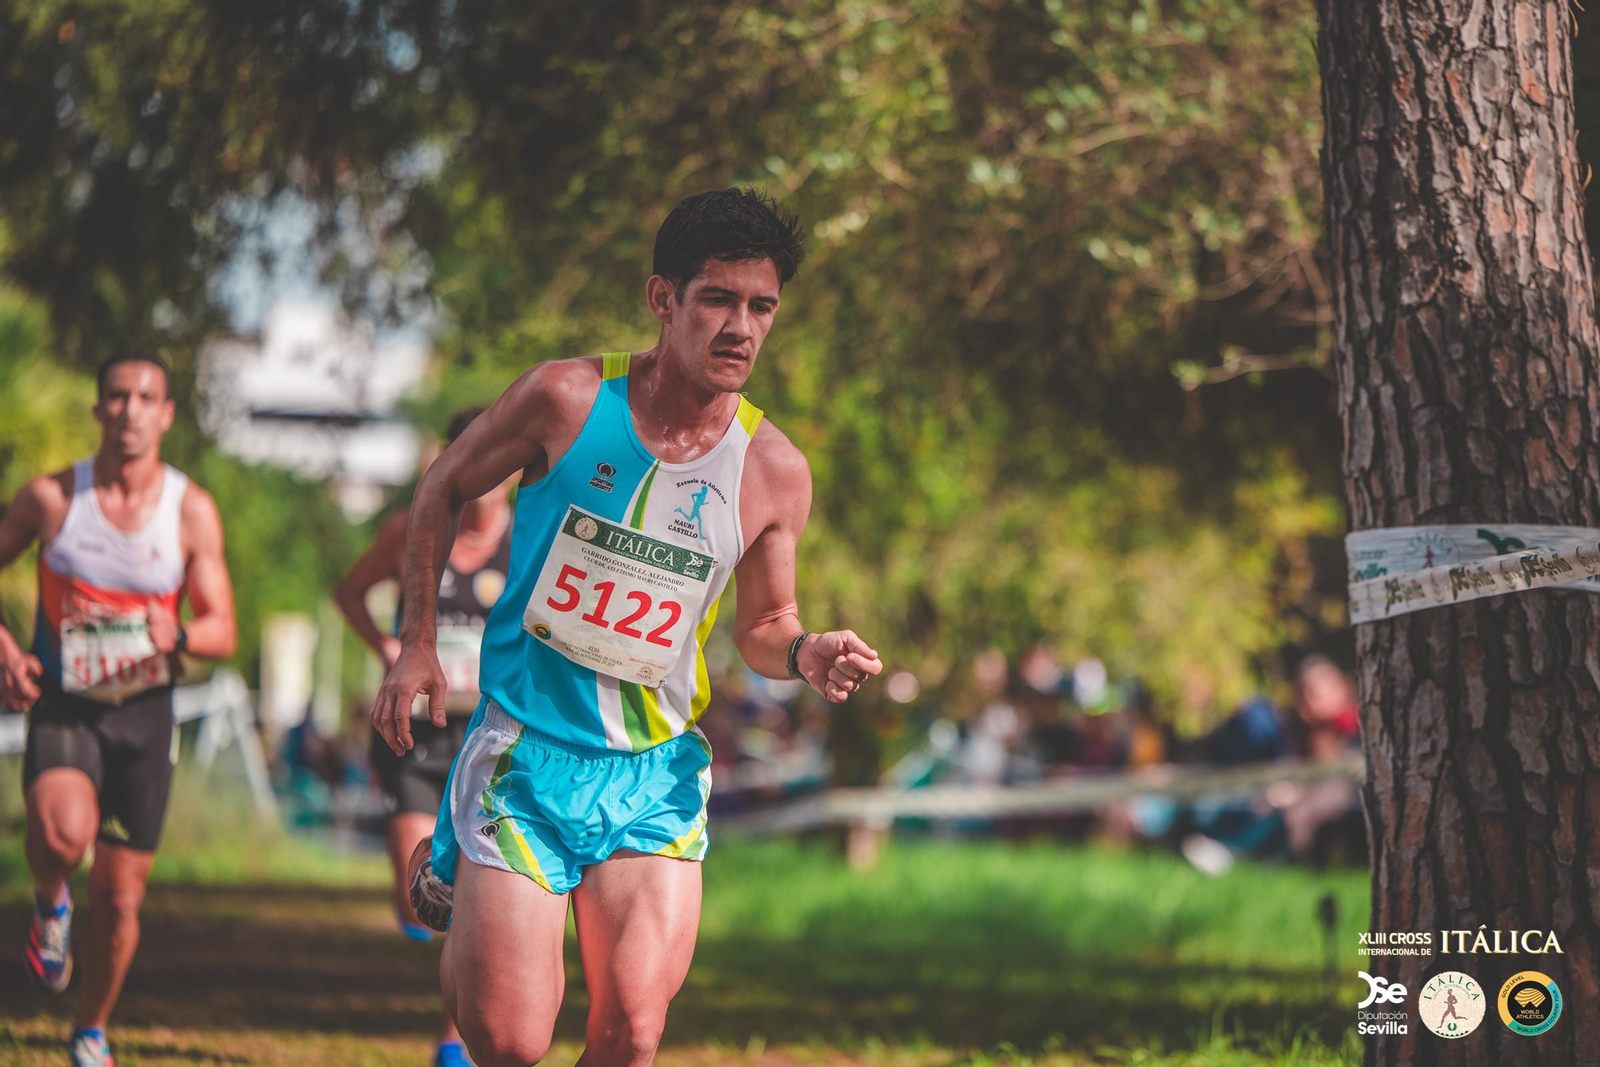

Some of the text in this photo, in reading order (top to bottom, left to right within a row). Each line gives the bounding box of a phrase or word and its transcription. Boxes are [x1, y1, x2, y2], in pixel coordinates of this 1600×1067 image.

[676, 478, 699, 488] Escuela
[708, 482, 727, 504] Atletismo
[668, 525, 698, 538] CASTILLO
[674, 519, 695, 530] MAURI
[605, 531, 675, 567] ITÁLICA
[581, 547, 612, 563] GARRIDO
[648, 572, 685, 587] ALEJANDRO
[606, 565, 637, 579] ATLETISMO
[654, 581, 679, 592] CASTILLO
[546, 563, 682, 648] 5122
